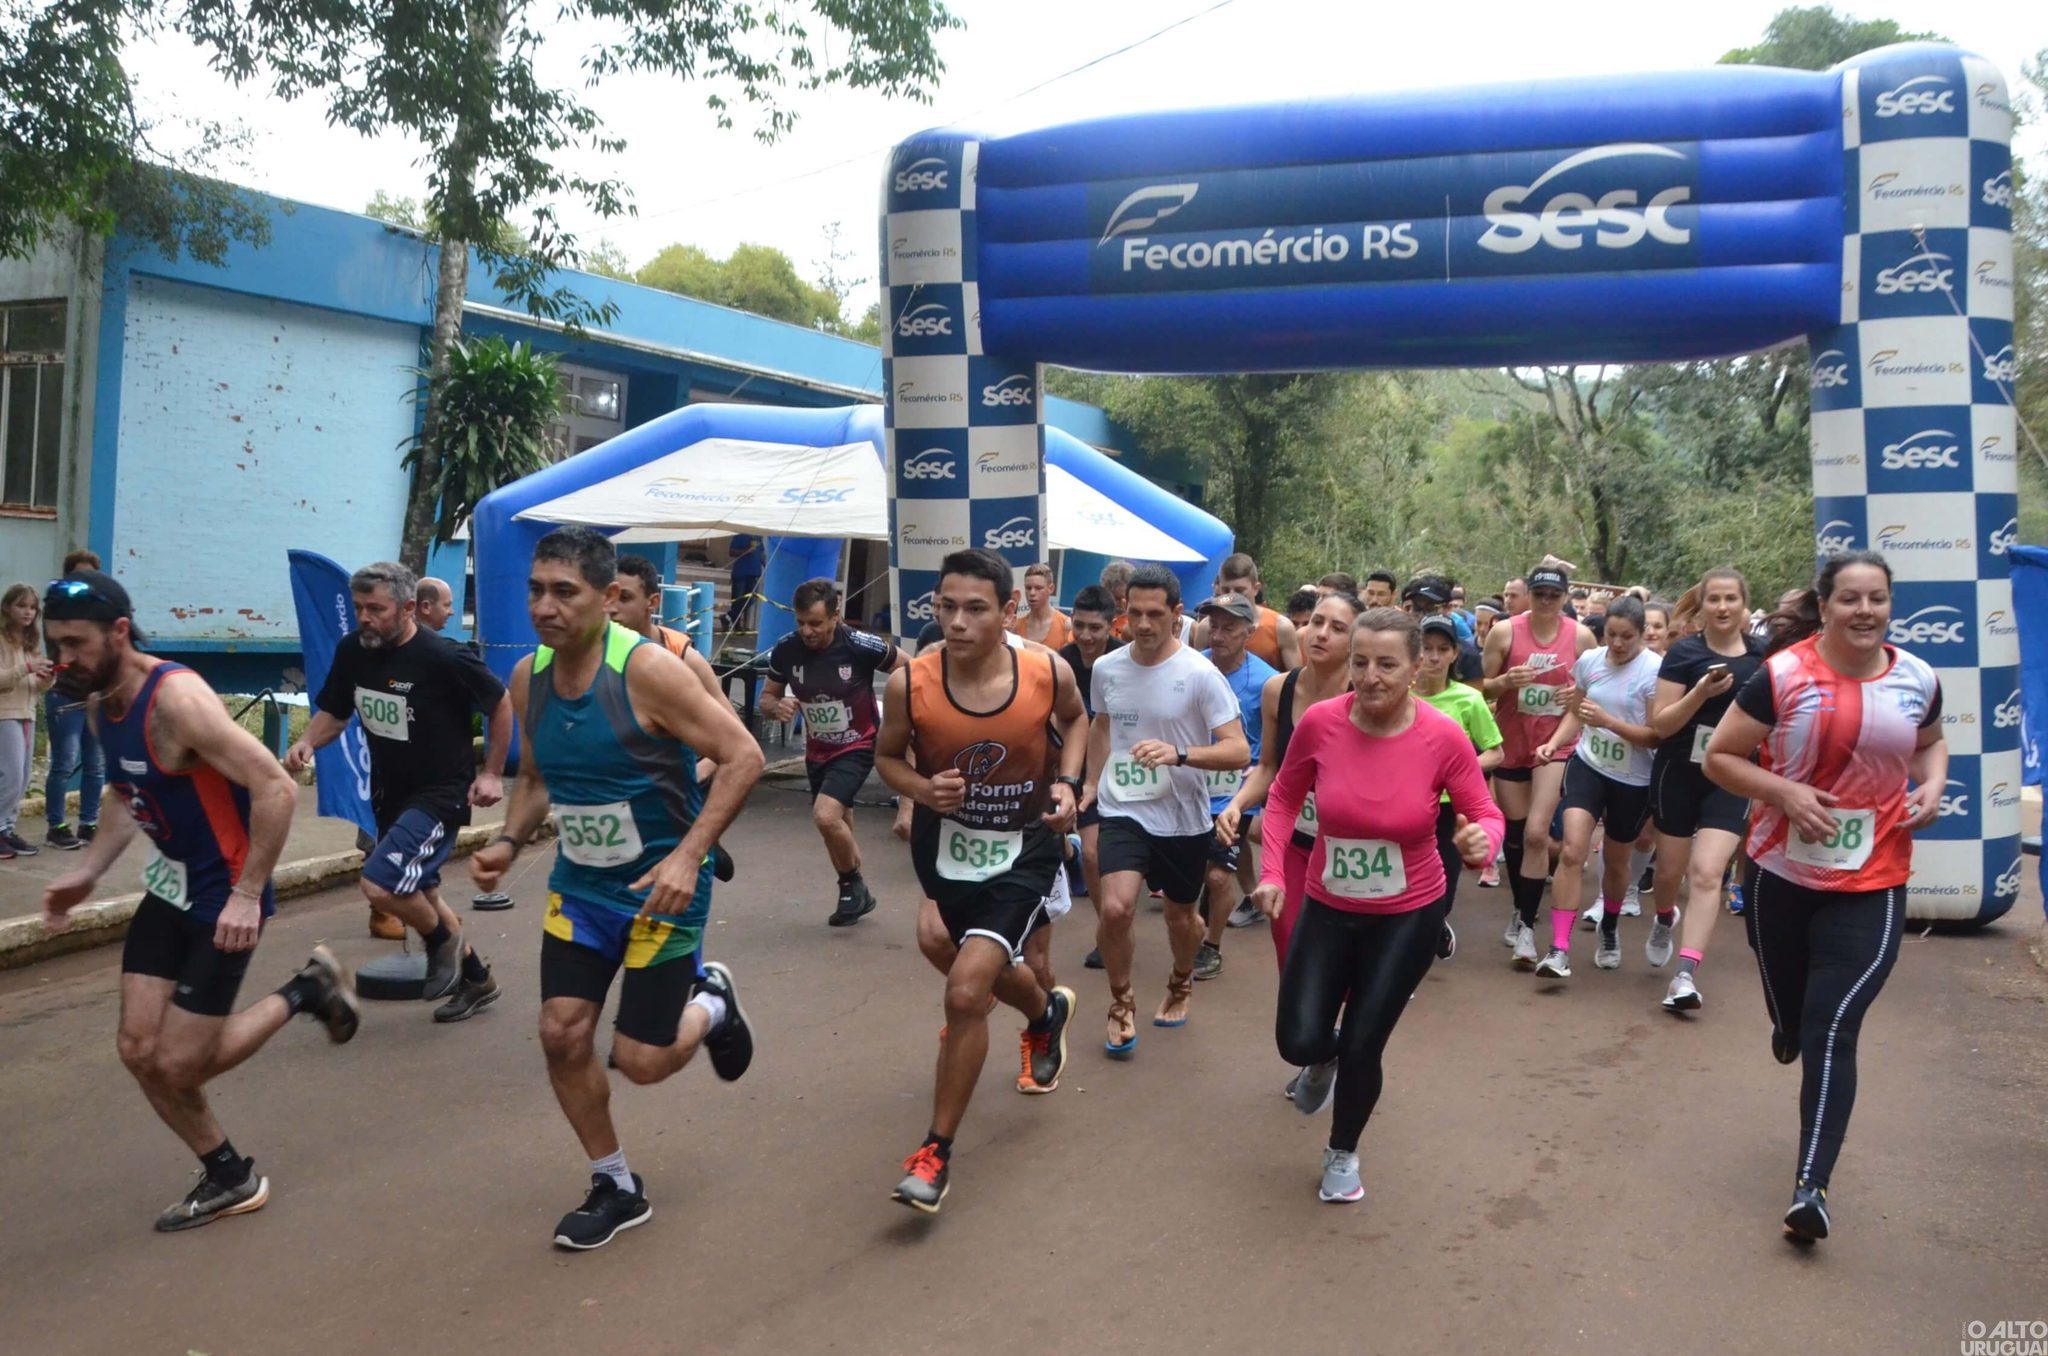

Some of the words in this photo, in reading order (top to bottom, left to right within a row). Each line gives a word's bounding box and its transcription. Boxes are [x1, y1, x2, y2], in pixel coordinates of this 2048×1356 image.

[1476, 185, 1691, 255] Sesc
[893, 248, 941, 260] Fecomércio
[942, 247, 957, 258] RS
[1123, 229, 1349, 272] Fecomércio
[1363, 223, 1420, 261] RS
[1811, 363, 1849, 389] esc
[899, 392, 948, 404] Fecomércio
[949, 393, 964, 403] RS
[903, 535, 949, 546] Fecomércio
[951, 536, 966, 546] RS
[1882, 538, 1953, 551] Fecomércio
[1955, 538, 1972, 550] RS
[1524, 687, 1556, 707] 60
[362, 695, 400, 726] 508
[806, 705, 841, 724] 682
[1960, 712, 1976, 724] RS
[1590, 735, 1625, 761] 616
[970, 780, 1035, 798] Forma
[961, 799, 1021, 812] demia
[992, 815, 1009, 824] RS
[561, 813, 627, 848] 552
[949, 831, 1010, 869] 635
[1331, 846, 1393, 880] 634
[1906, 885, 1960, 896] comércio
[1962, 885, 1978, 896] RS
